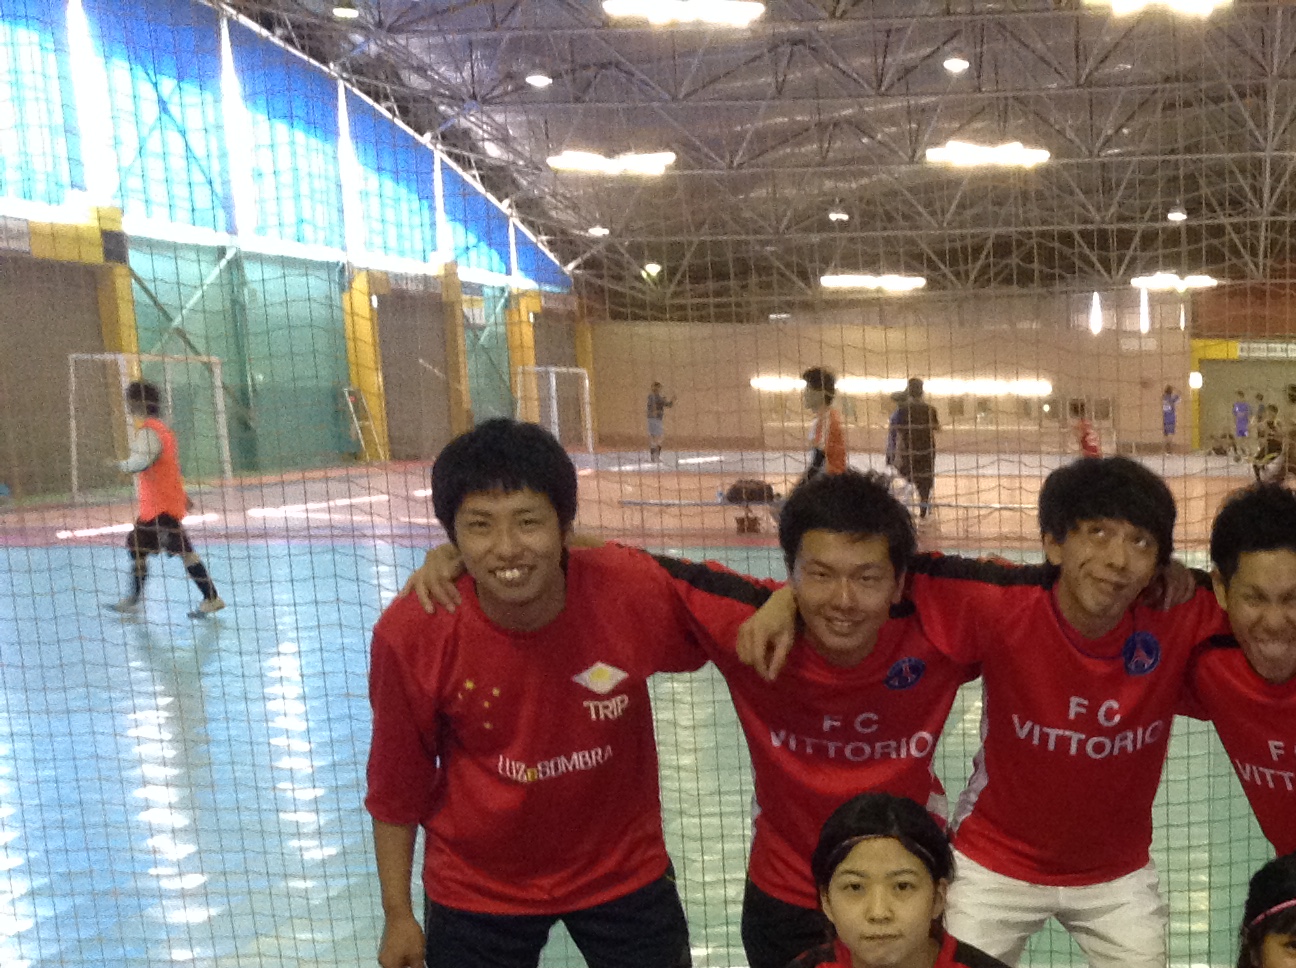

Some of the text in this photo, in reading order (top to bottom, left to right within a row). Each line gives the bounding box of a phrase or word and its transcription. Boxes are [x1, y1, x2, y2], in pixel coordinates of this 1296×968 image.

[583, 694, 629, 721] TRIP
[770, 729, 933, 762] VITTORIO
[1011, 714, 1163, 760] VITTORIO
